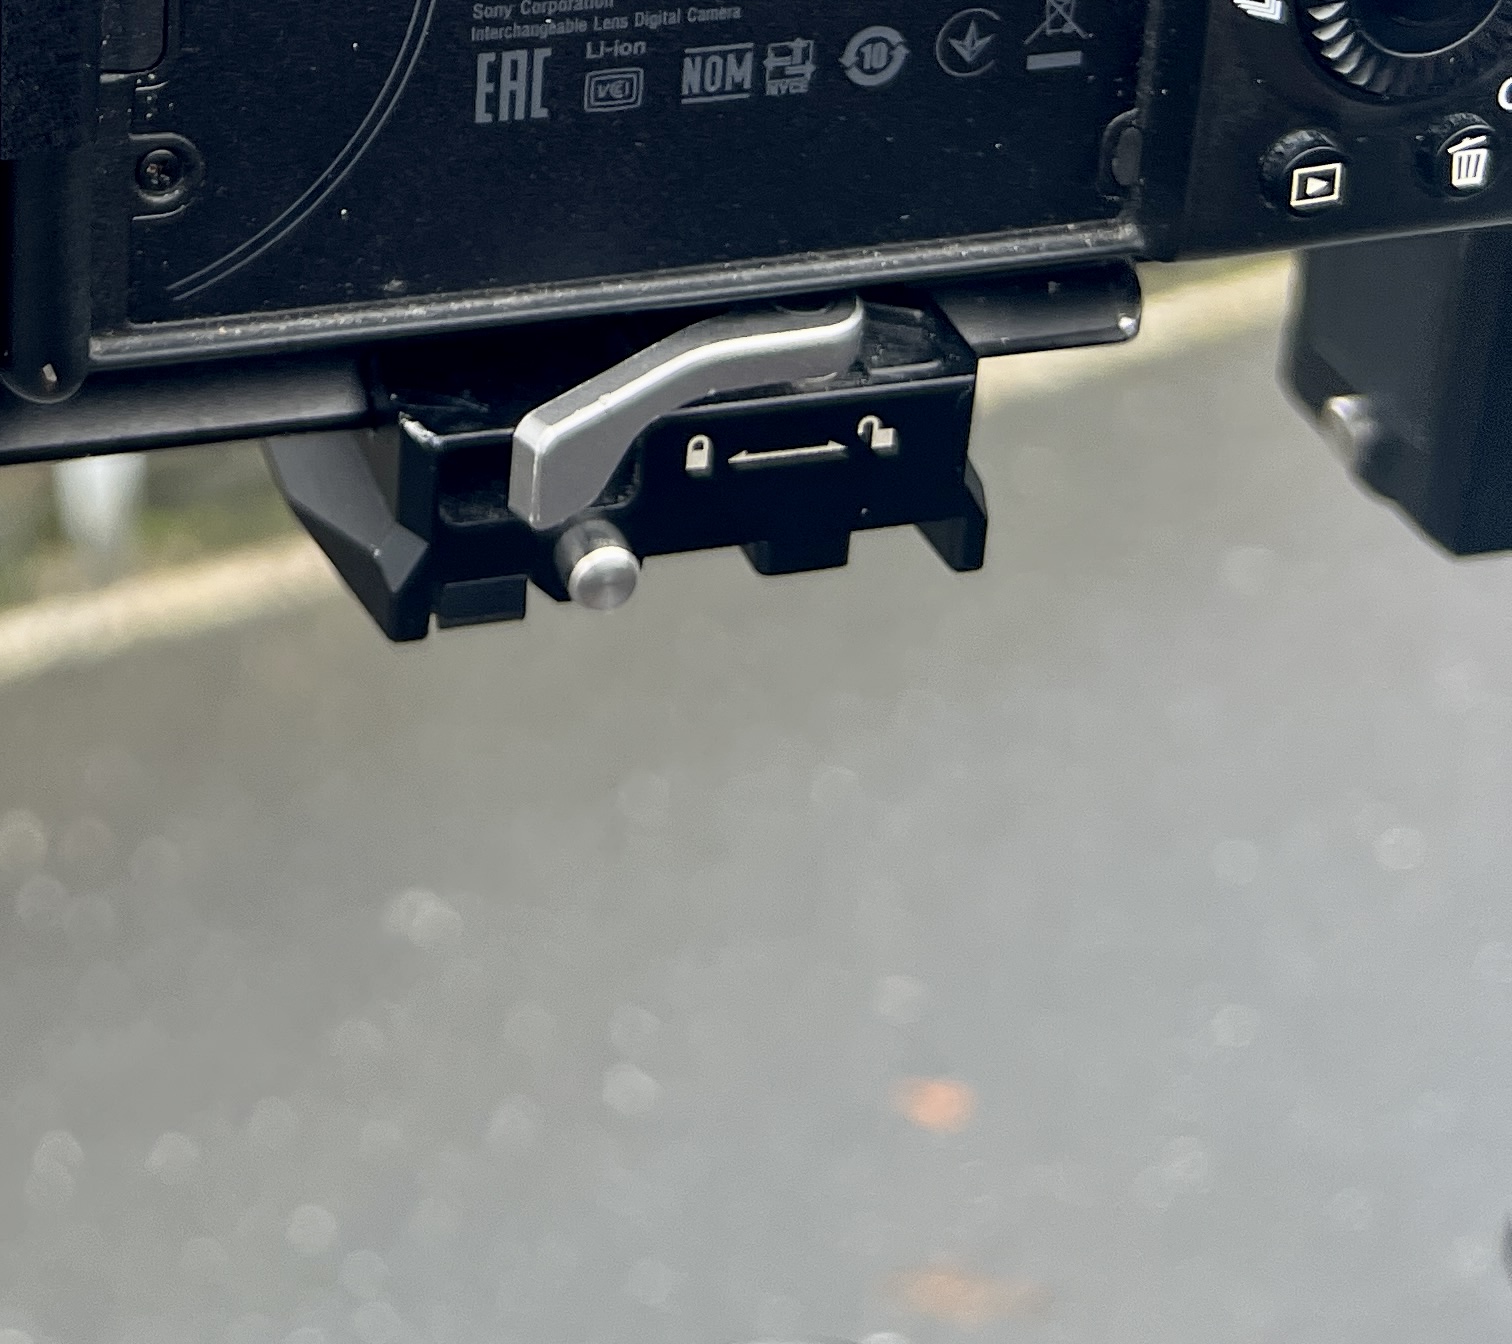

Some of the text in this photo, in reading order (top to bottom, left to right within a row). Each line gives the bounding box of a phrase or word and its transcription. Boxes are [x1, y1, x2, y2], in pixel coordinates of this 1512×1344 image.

[471, 3, 513, 21] Sony
[471, 5, 742, 42] Interchangeable Lens Digital Camera
[859, 41, 888, 70] 10
[681, 50, 754, 96] NOM
